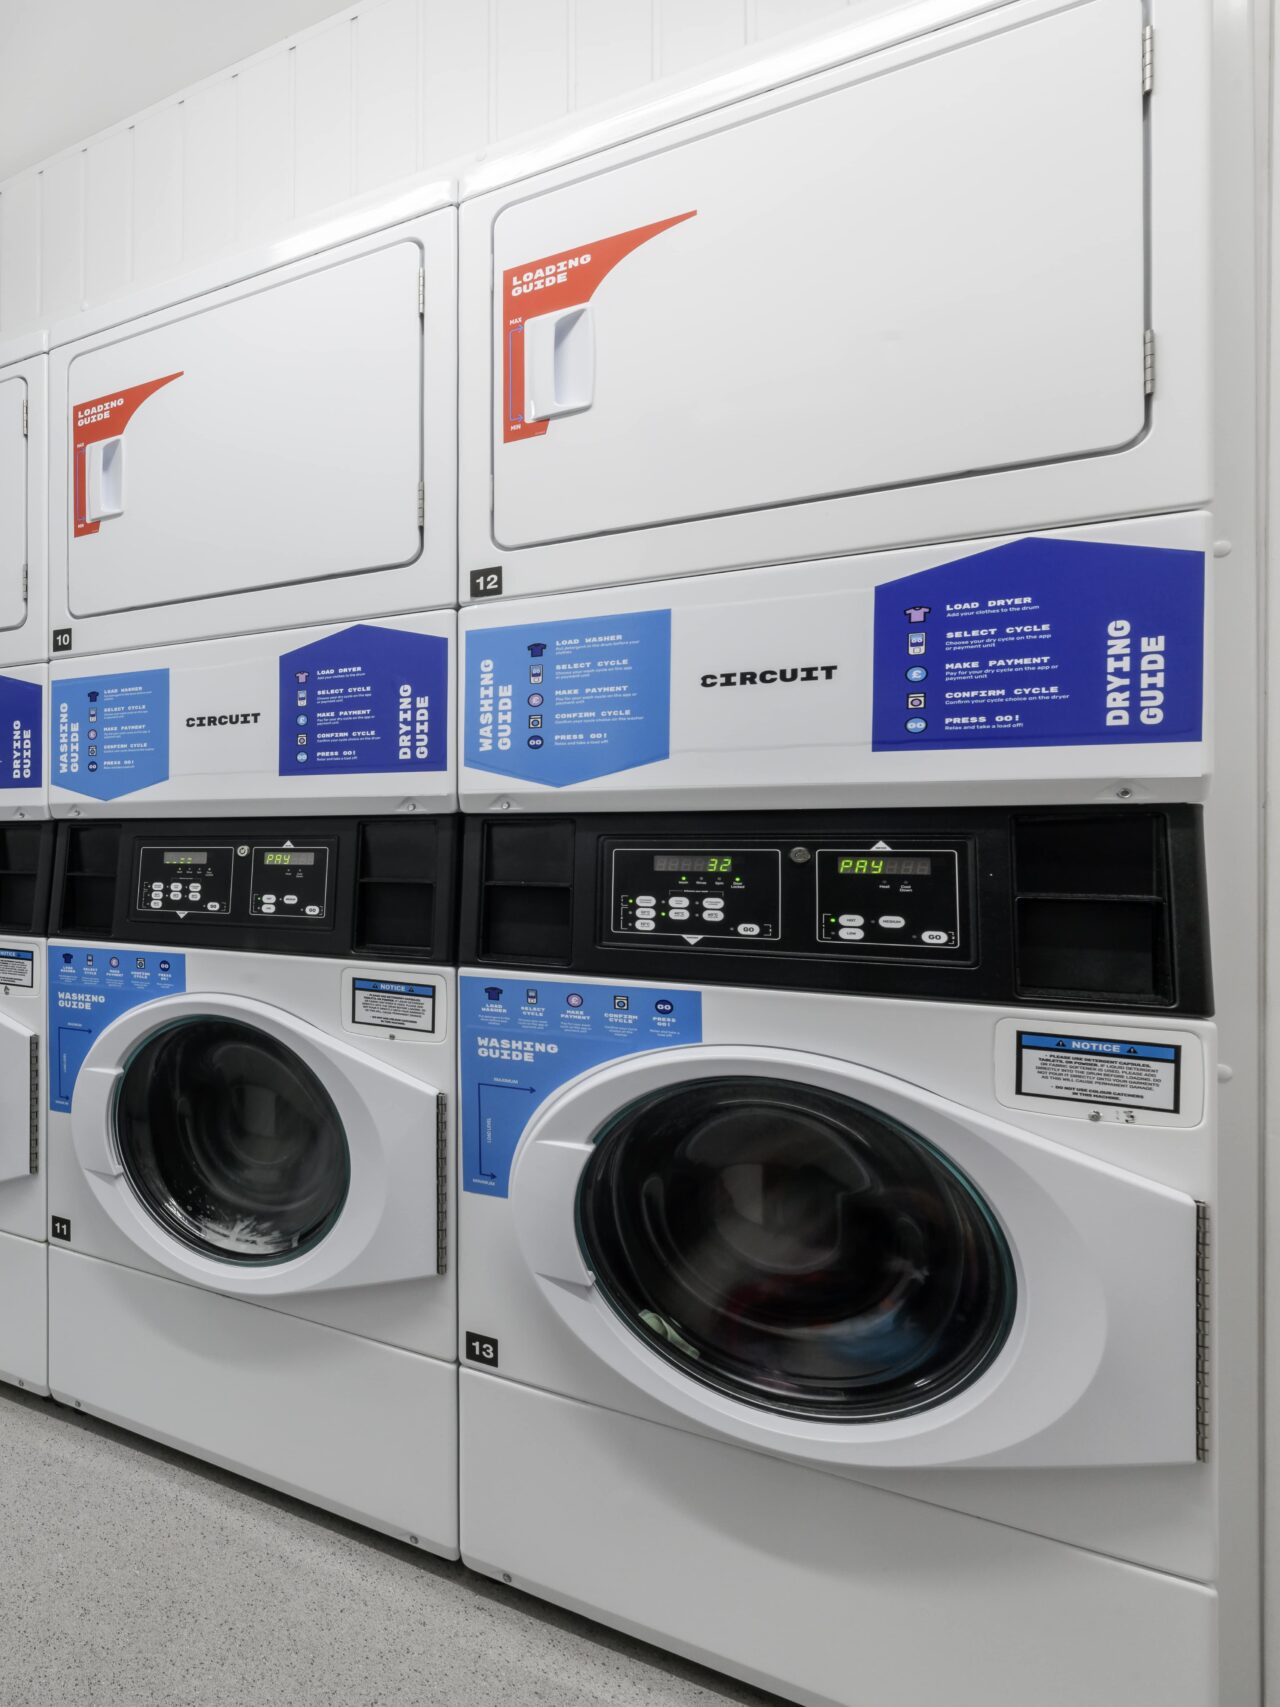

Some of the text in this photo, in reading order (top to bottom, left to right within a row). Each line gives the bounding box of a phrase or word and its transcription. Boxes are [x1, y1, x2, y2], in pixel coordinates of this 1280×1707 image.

[512, 254, 592, 286] LOADING
[512, 272, 568, 296] GUIDE
[509, 317, 522, 325] MAX
[78, 398, 124, 418] LOADING
[78, 411, 110, 427] GUIDE
[475, 574, 498, 591] 12
[946, 597, 1032, 611] LOAD DRYER
[585, 634, 622, 643] WASHER
[946, 624, 1050, 638] SELECT CYCLE
[56, 634, 69, 646] 10
[556, 662, 591, 670] SELECT
[945, 657, 1050, 670] MAKE PAYMENT
[700, 665, 838, 688] CIRCUIT
[1106, 619, 1131, 726] DRYING
[1140, 635, 1165, 725] GUIDE
[585, 685, 628, 693] PAYMENT
[945, 686, 1059, 698] CONFIRM CYCLE
[479, 659, 494, 752] WASHING
[186, 713, 261, 727] CIRCUIT
[399, 684, 411, 760] DRYING
[498, 684, 512, 750] GUIDE
[416, 696, 429, 759] GUIDE
[60, 703, 68, 774] WASHING
[13, 720, 21, 779] DRYING
[23, 729, 31, 778] GUIDE
[71, 723, 79, 772] GUIDE
[267, 854, 291, 864] PAY
[707, 859, 731, 871] 32
[840, 860, 883, 874] PAY
[58, 992, 105, 1003] WASHING
[58, 1001, 91, 1010] GUIDE
[477, 1037, 558, 1053] WASHING
[1072, 1041, 1120, 1052] NOTICE
[478, 1048, 534, 1062] GUIDE
[55, 1222, 66, 1235] 11
[472, 1341, 493, 1358] 13
